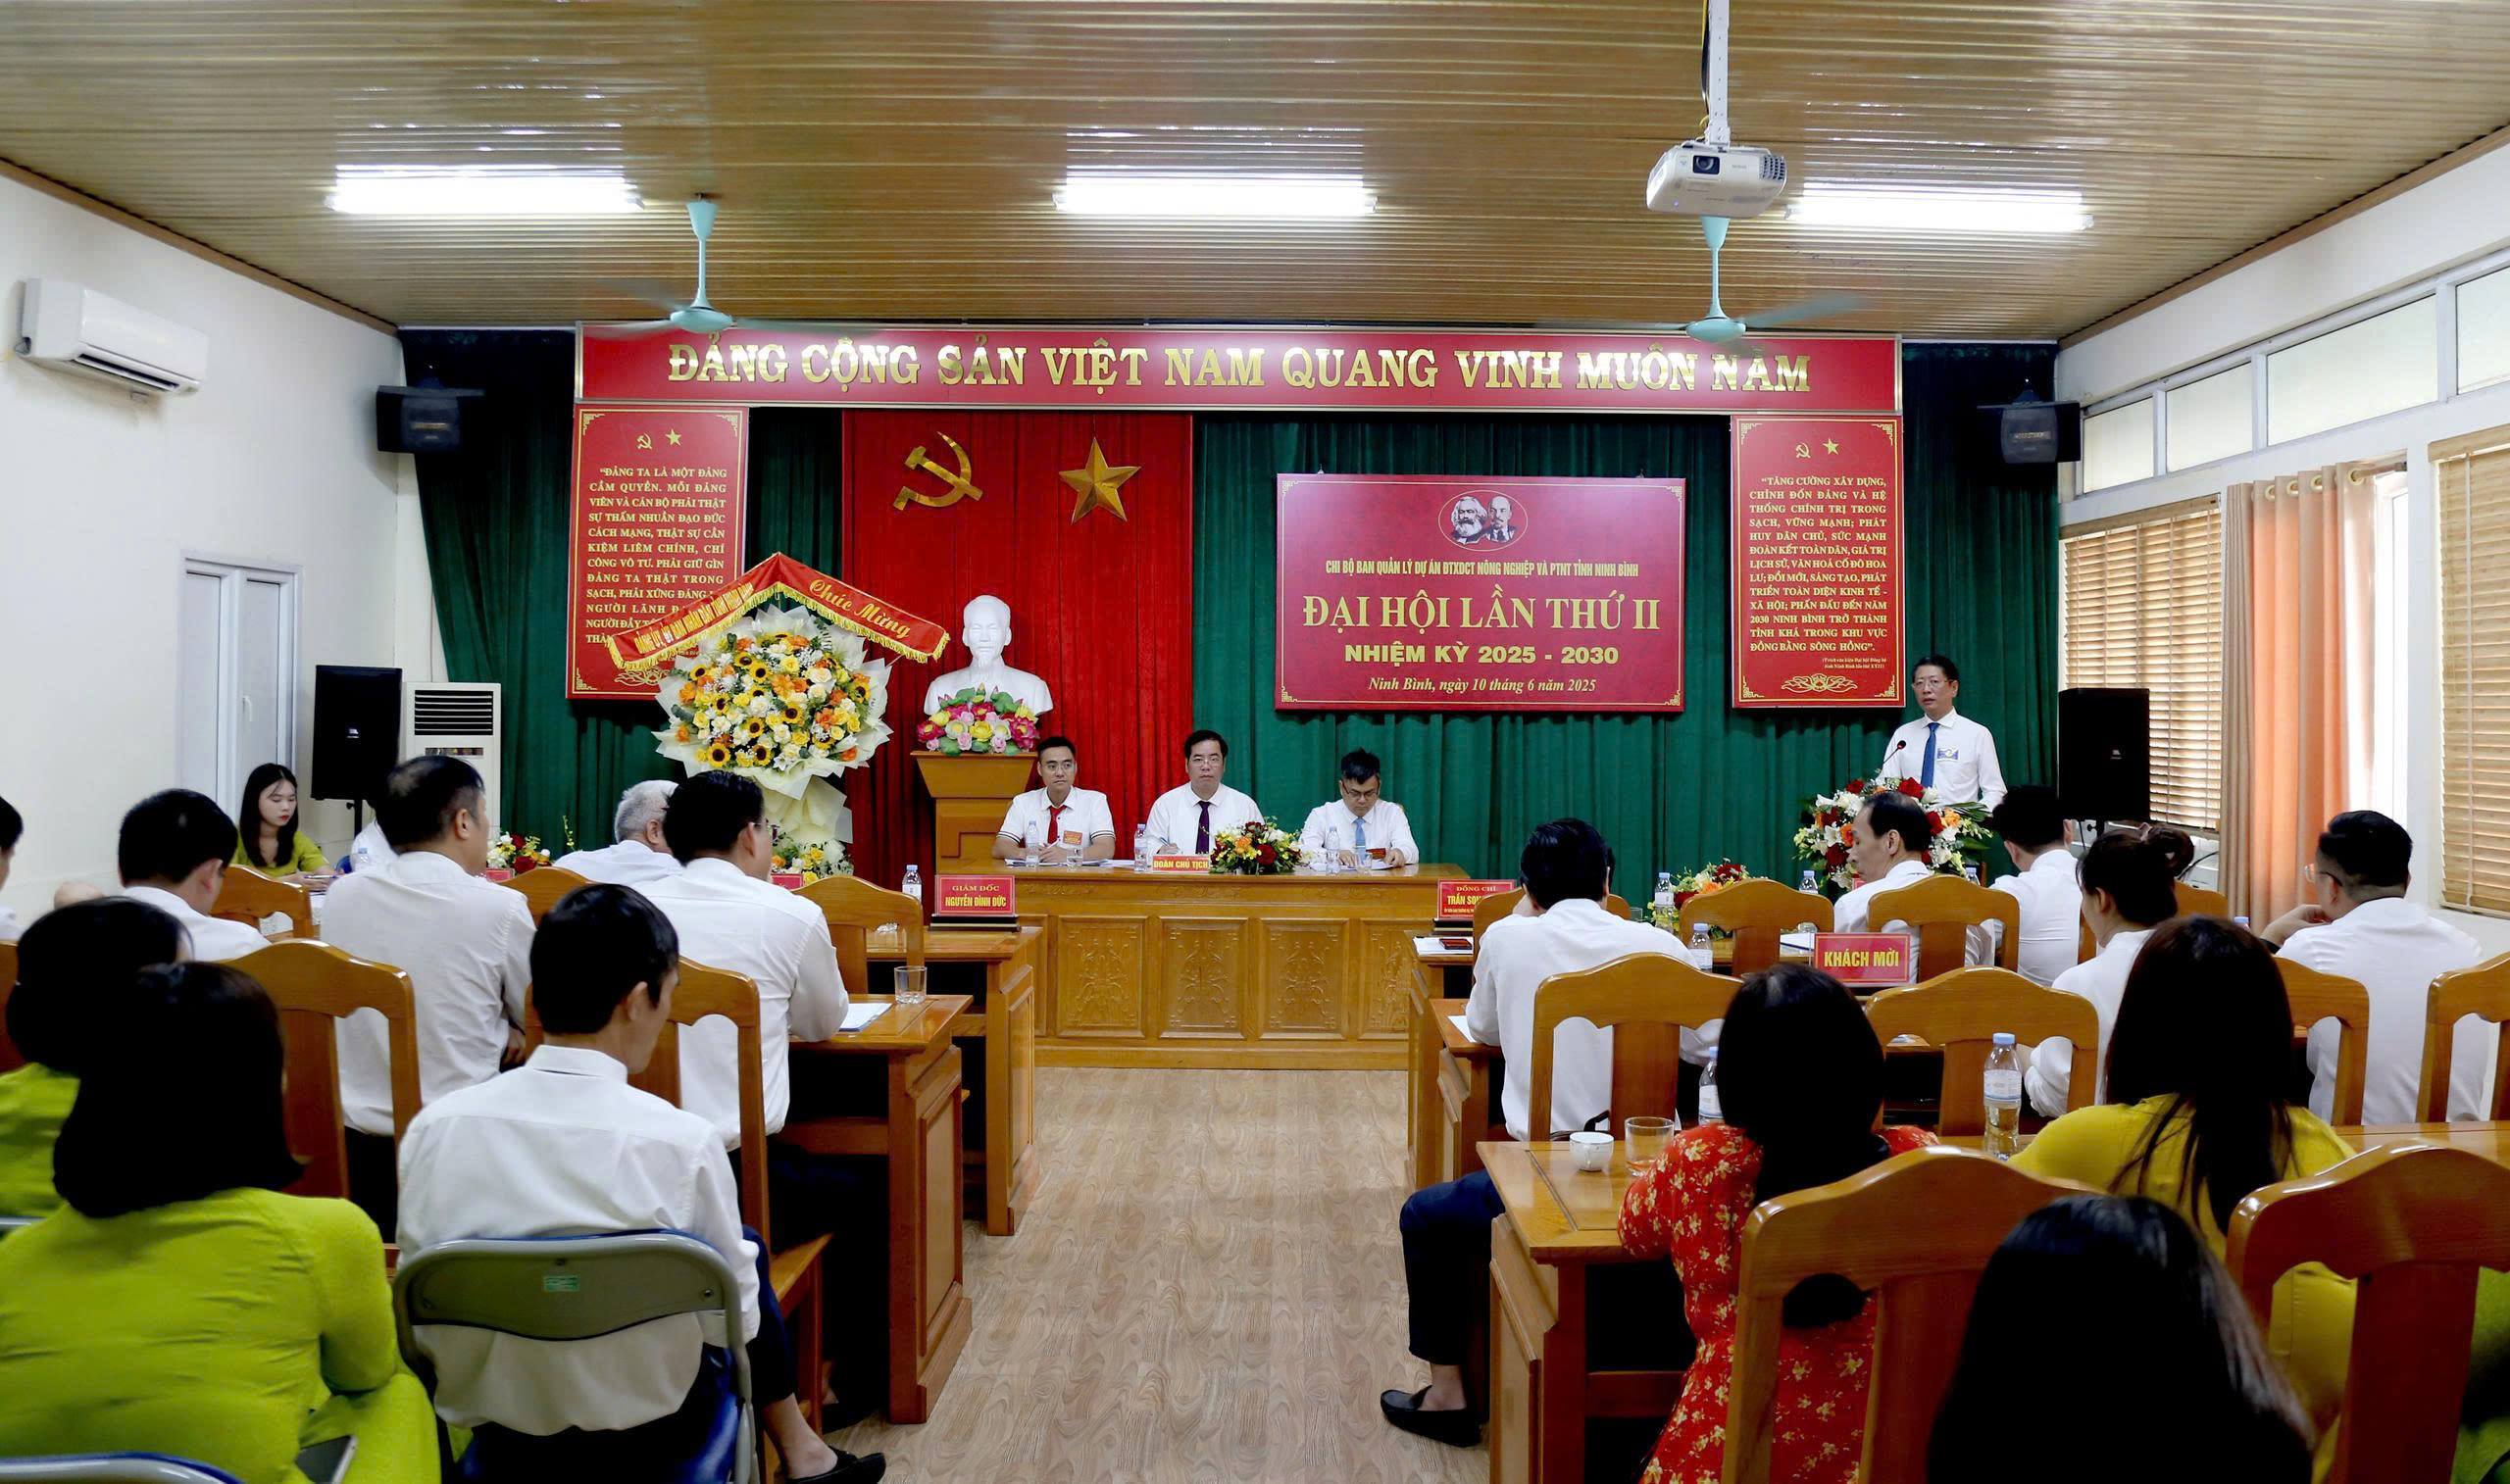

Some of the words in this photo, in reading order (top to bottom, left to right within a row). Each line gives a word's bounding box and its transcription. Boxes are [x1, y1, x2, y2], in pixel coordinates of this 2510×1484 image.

[669, 331, 789, 383] ĐẢNG
[802, 337, 921, 393] CỘNG
[937, 334, 1027, 386] SẢN
[1040, 337, 1149, 395] VIỆT
[1165, 346, 1265, 388] NAM
[1282, 346, 1438, 389] QUANG
[1454, 349, 1564, 390] VINH
[1577, 343, 1698, 391] MUÔN
[1711, 345, 1811, 392] NĂM
[1327, 561, 1340, 573] CHI
[1343, 558, 1354, 576] BỘ
[1357, 561, 1374, 573] BAN
[1377, 557, 1400, 575] QUẢN
[1402, 559, 1412, 573] LÝ
[1415, 561, 1428, 577] DỰ
[1429, 559, 1440, 574] ÁN
[1443, 562, 1475, 574] ĐTXDCT
[1478, 560, 1501, 574] NÔNG
[1504, 560, 1534, 578] NGHIỆP
[1537, 561, 1547, 575] VÀ
[1550, 563, 1571, 575] PTNT
[1574, 559, 1592, 575] TỈNH
[1595, 564, 1616, 576] NINH
[1619, 561, 1638, 576] BÌNH
[810, 579, 852, 611] Chúc
[854, 603, 911, 639] Mừng
[1303, 596, 1368, 633] ĐẠI
[1380, 590, 1449, 634] HỘI
[1459, 584, 1535, 627] LẦN
[1545, 590, 1625, 629] THỨ
[1632, 600, 1660, 629] II
[1345, 641, 1425, 667] NHIỆM
[1434, 641, 1469, 663] KỲ
[1478, 646, 1535, 663] 2025
[1561, 647, 1618, 664] 2030
[1370, 677, 1399, 689] Ninh
[1405, 677, 1435, 692] Bình,
[1440, 678, 1468, 693] ngày
[1473, 678, 1485, 690] 10
[1489, 678, 1523, 694] tháng
[1528, 679, 1534, 691] 6
[1538, 679, 1563, 690] năm
[1568, 679, 1596, 691] 2025
[1176, 858, 1189, 867] CHỦ
[1192, 861, 1207, 869] TỊCH
[1447, 892, 1465, 905] TRẦN
[1824, 948, 1869, 966] KHÁCH
[1874, 948, 1899, 966] MỜI
